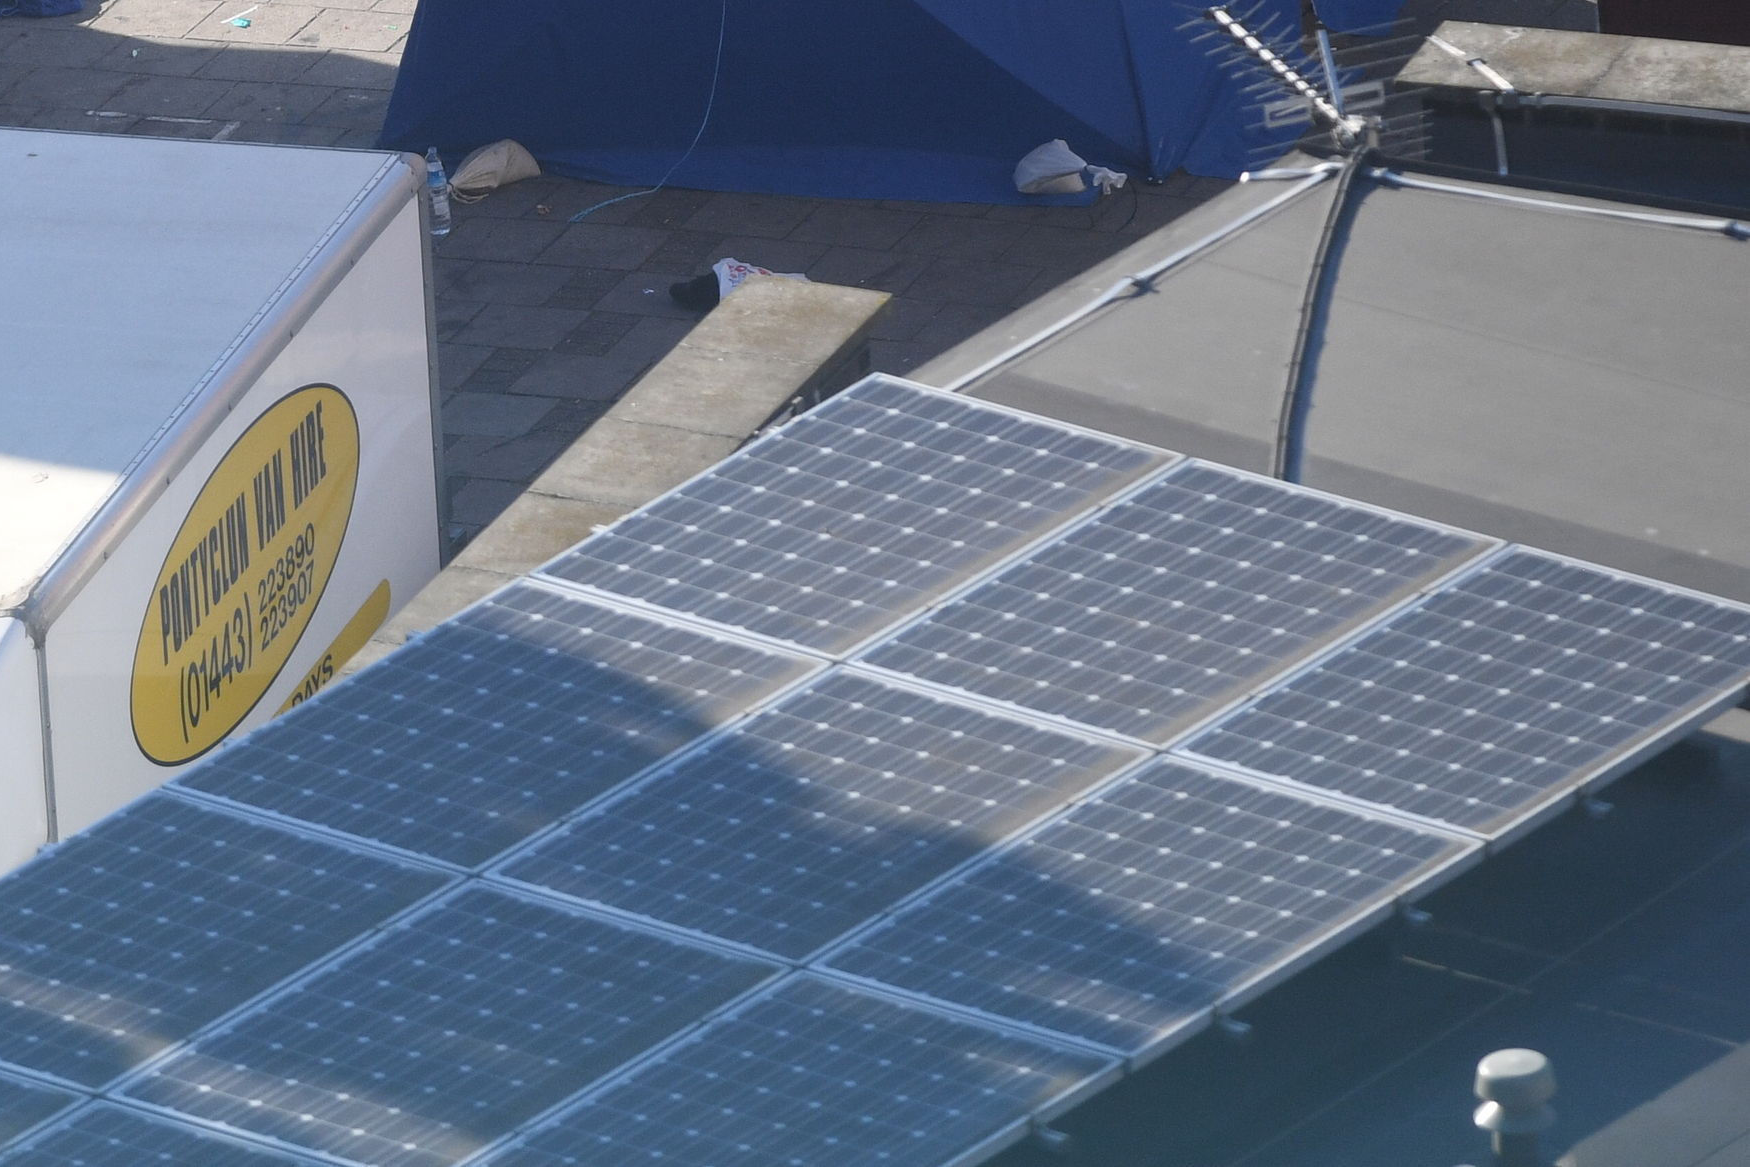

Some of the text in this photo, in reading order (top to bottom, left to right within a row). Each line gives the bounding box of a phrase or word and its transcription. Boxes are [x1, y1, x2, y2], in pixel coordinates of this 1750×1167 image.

[159, 399, 327, 666] PONTYCLUN VAN HIRE
[180, 523, 315, 744] (01443) 223890
[260, 560, 315, 652] 223907
